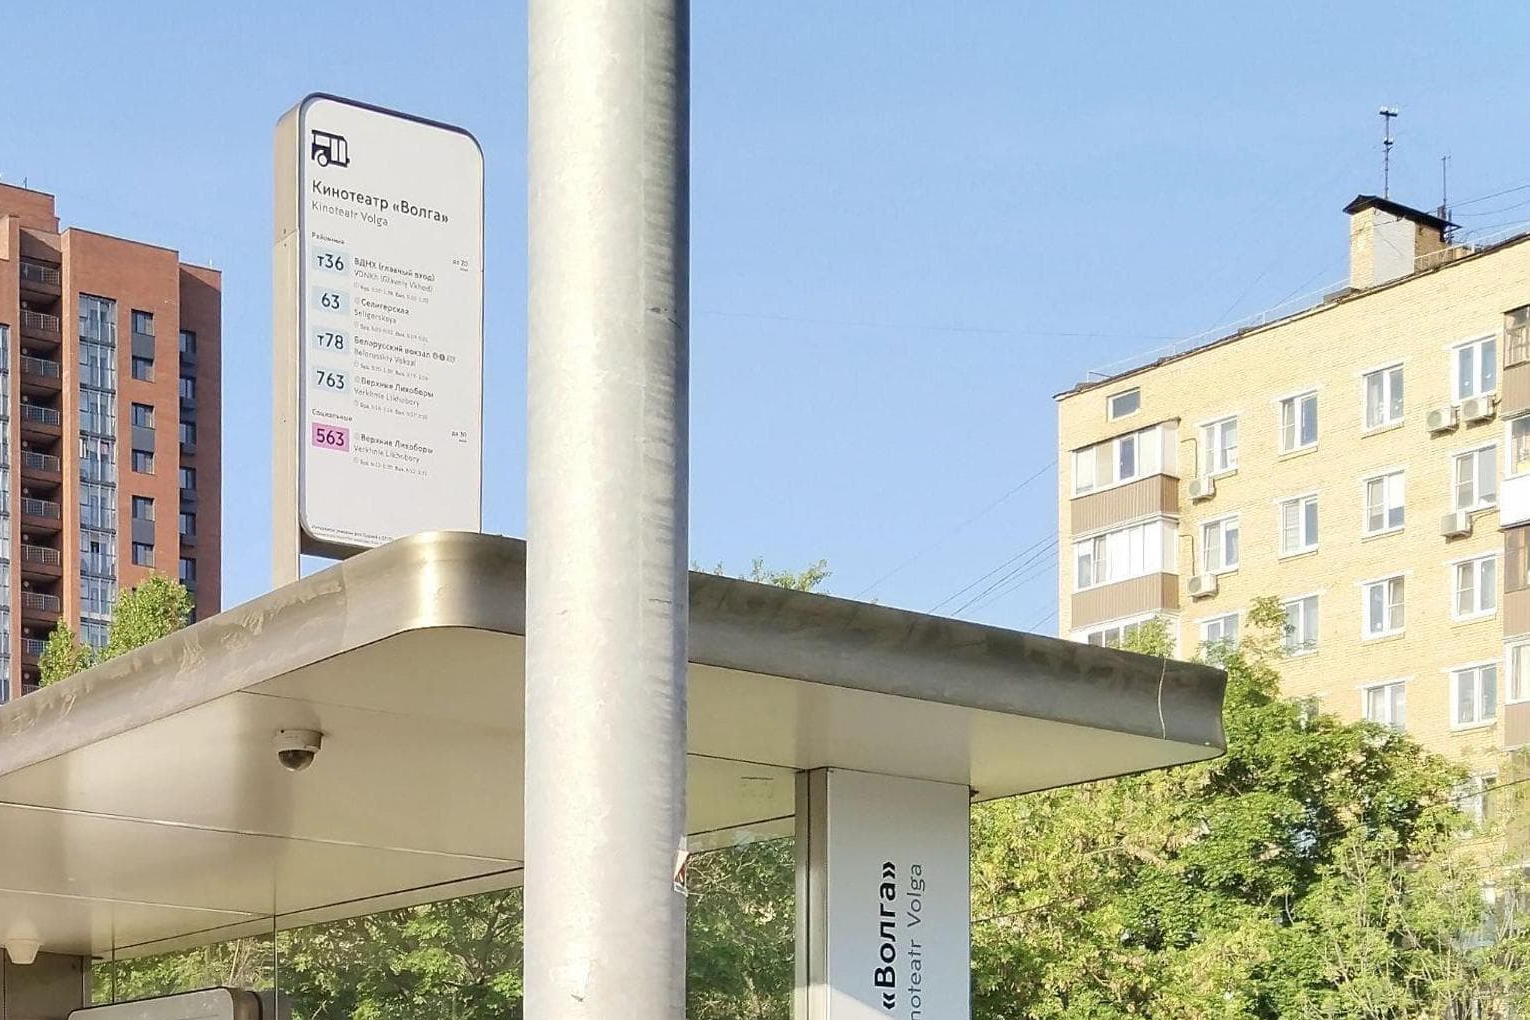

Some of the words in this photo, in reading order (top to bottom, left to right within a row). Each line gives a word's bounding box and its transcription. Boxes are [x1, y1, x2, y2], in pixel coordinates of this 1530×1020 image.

[312, 179, 389, 211] Кинотеатр
[393, 200, 449, 224] «Волга»
[312, 200, 358, 219] Kinoteatr
[360, 211, 389, 227] Volga
[354, 257, 377, 269] ВДНХ
[321, 293, 340, 309] 63
[361, 298, 409, 315] Селигерская
[354, 335, 403, 353] Белорусский
[317, 370, 345, 389] 763
[316, 428, 345, 447] 563
[906, 863, 926, 928] Volga
[874, 861, 897, 1010] «Волга»
